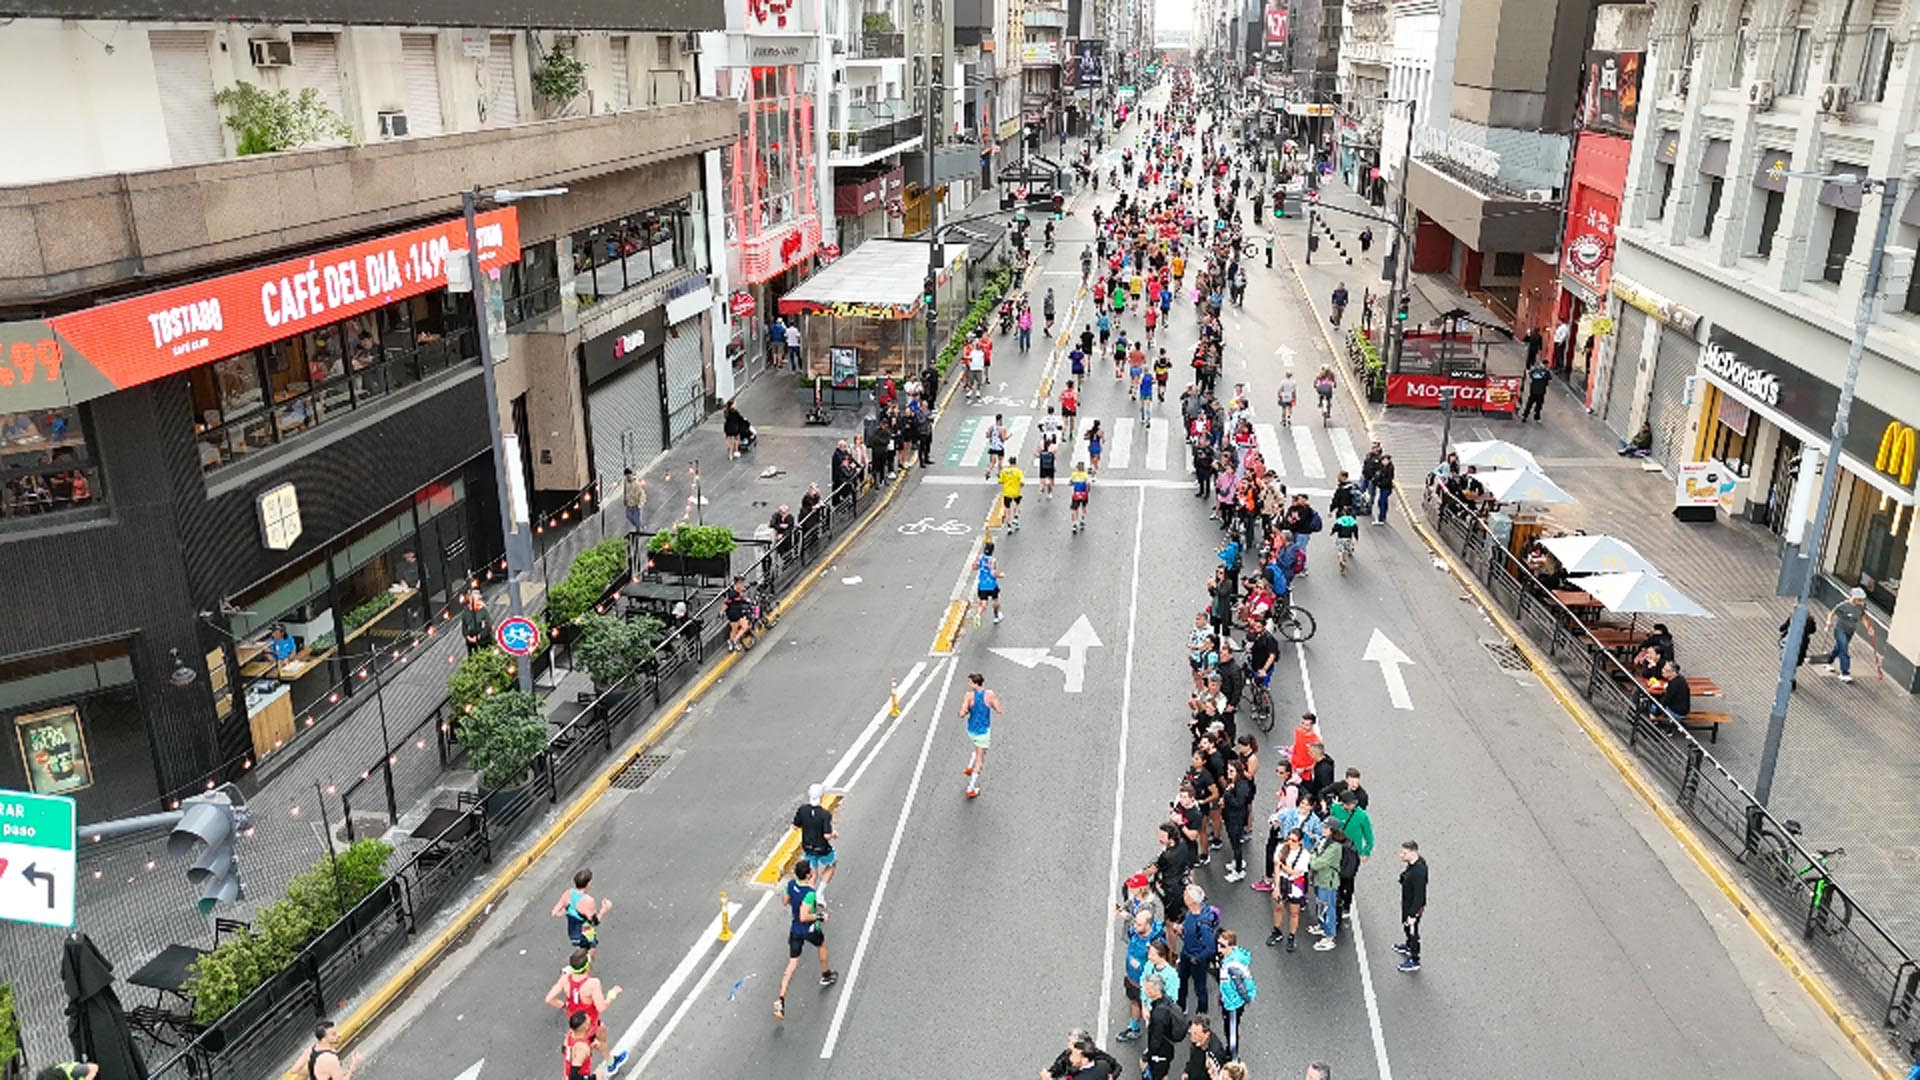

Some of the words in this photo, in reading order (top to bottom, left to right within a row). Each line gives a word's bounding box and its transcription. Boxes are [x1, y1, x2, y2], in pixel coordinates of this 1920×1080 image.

[261, 259, 324, 327] CAFÉ
[324, 258, 367, 309] DEL
[366, 250, 402, 296] DIA
[147, 297, 223, 348] TOSTADO
[1698, 341, 1779, 405] McDonald's
[3, 823, 36, 838] paso
